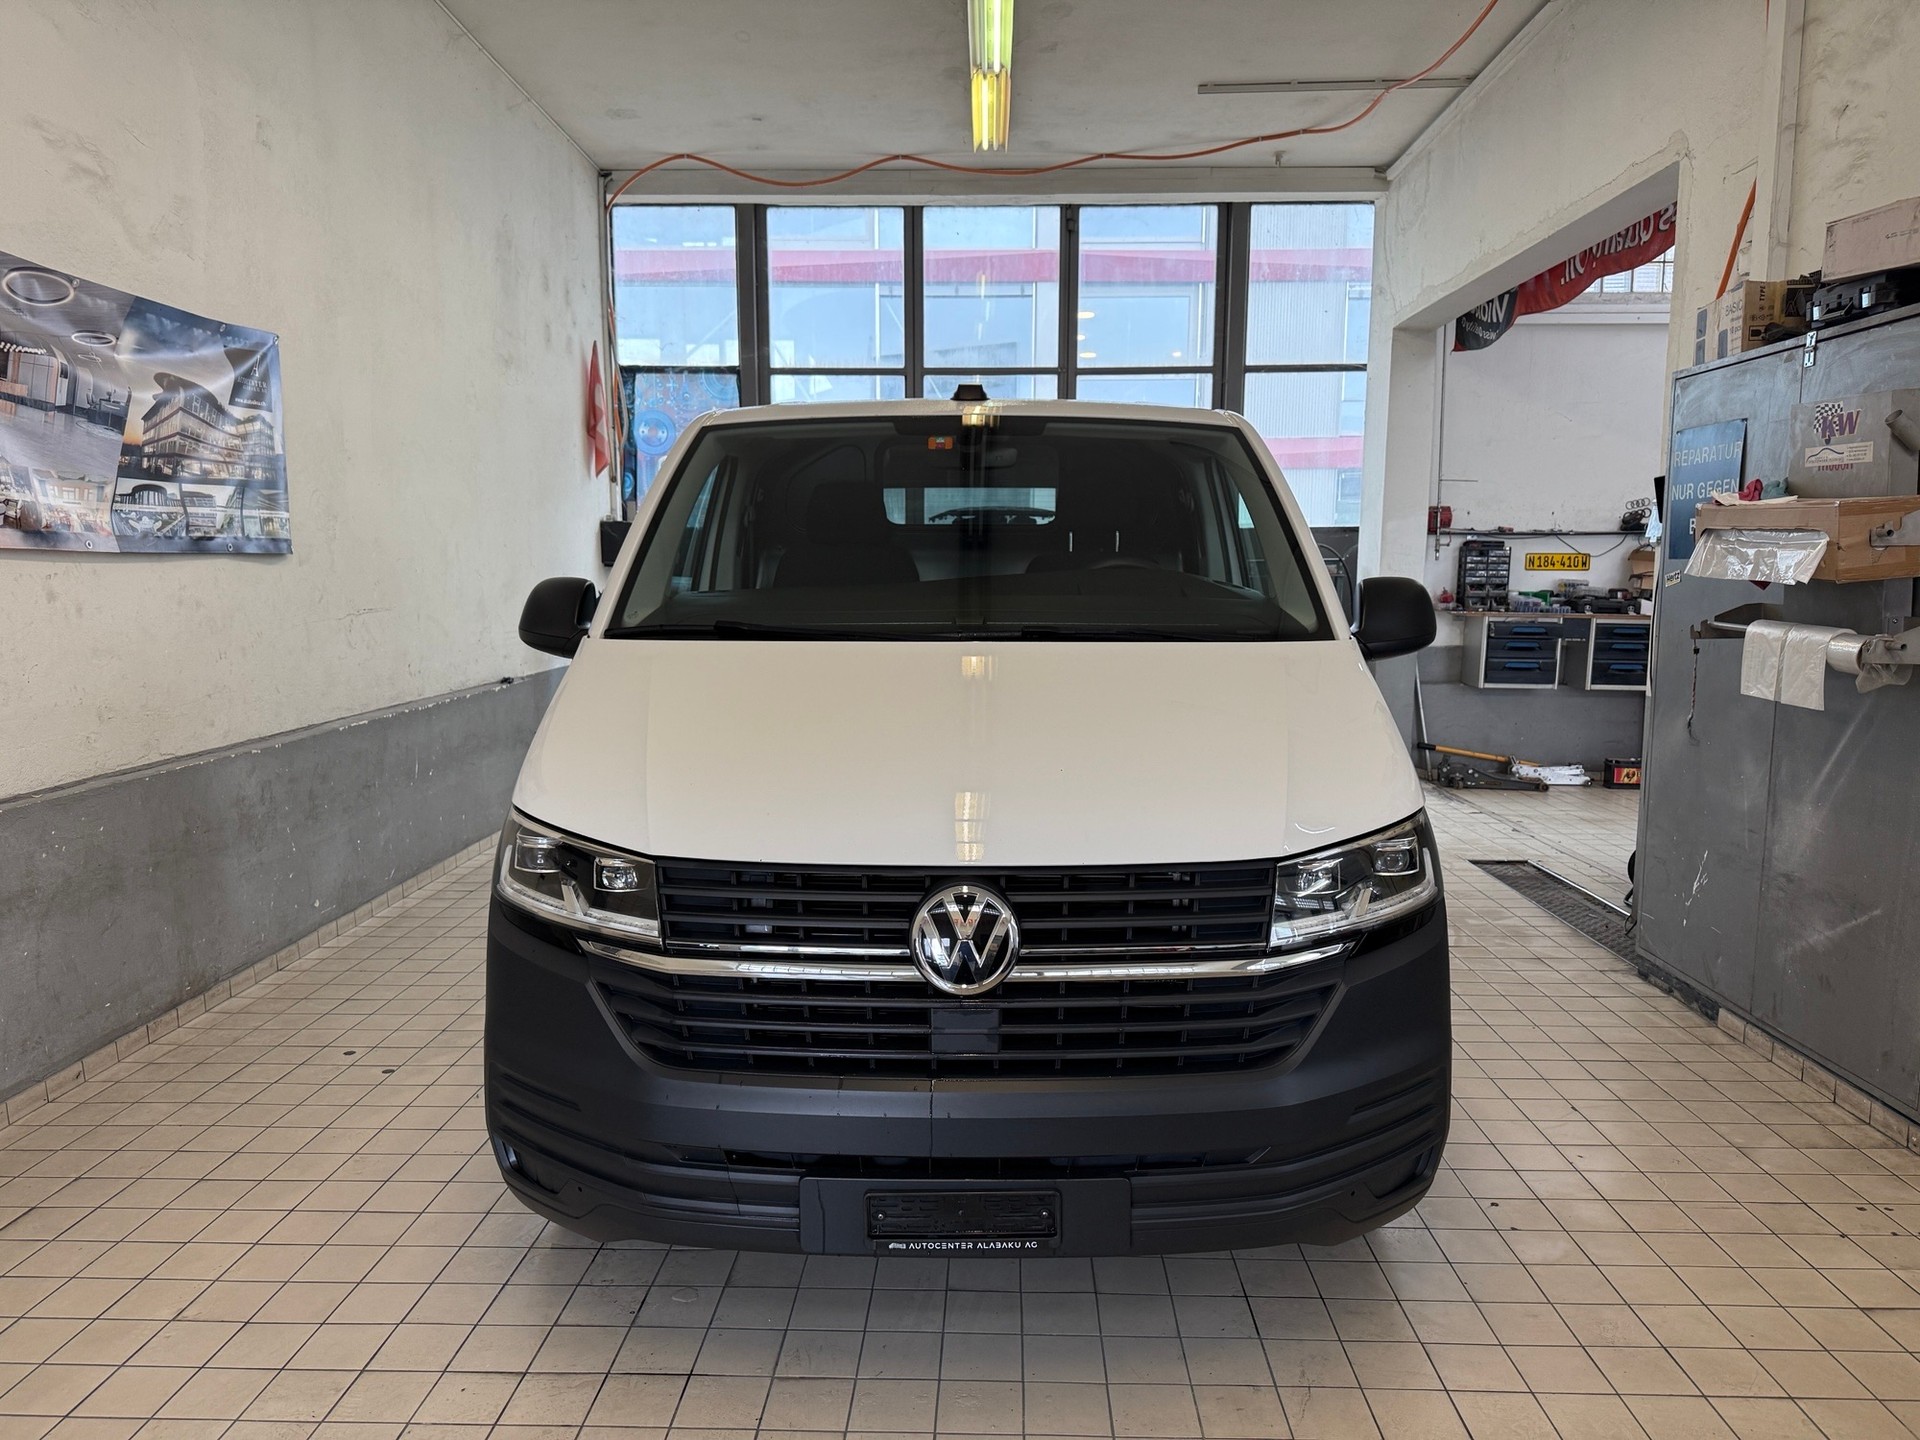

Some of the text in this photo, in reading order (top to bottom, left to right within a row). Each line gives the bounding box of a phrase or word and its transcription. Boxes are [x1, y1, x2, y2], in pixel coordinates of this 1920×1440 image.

[1820, 408, 1862, 439] KW
[1673, 440, 1743, 467] REPARATUR
[1671, 478, 1740, 501] NUR GEGEN
[908, 1240, 1038, 1250] AUTOCENTER ALABAKU AG
